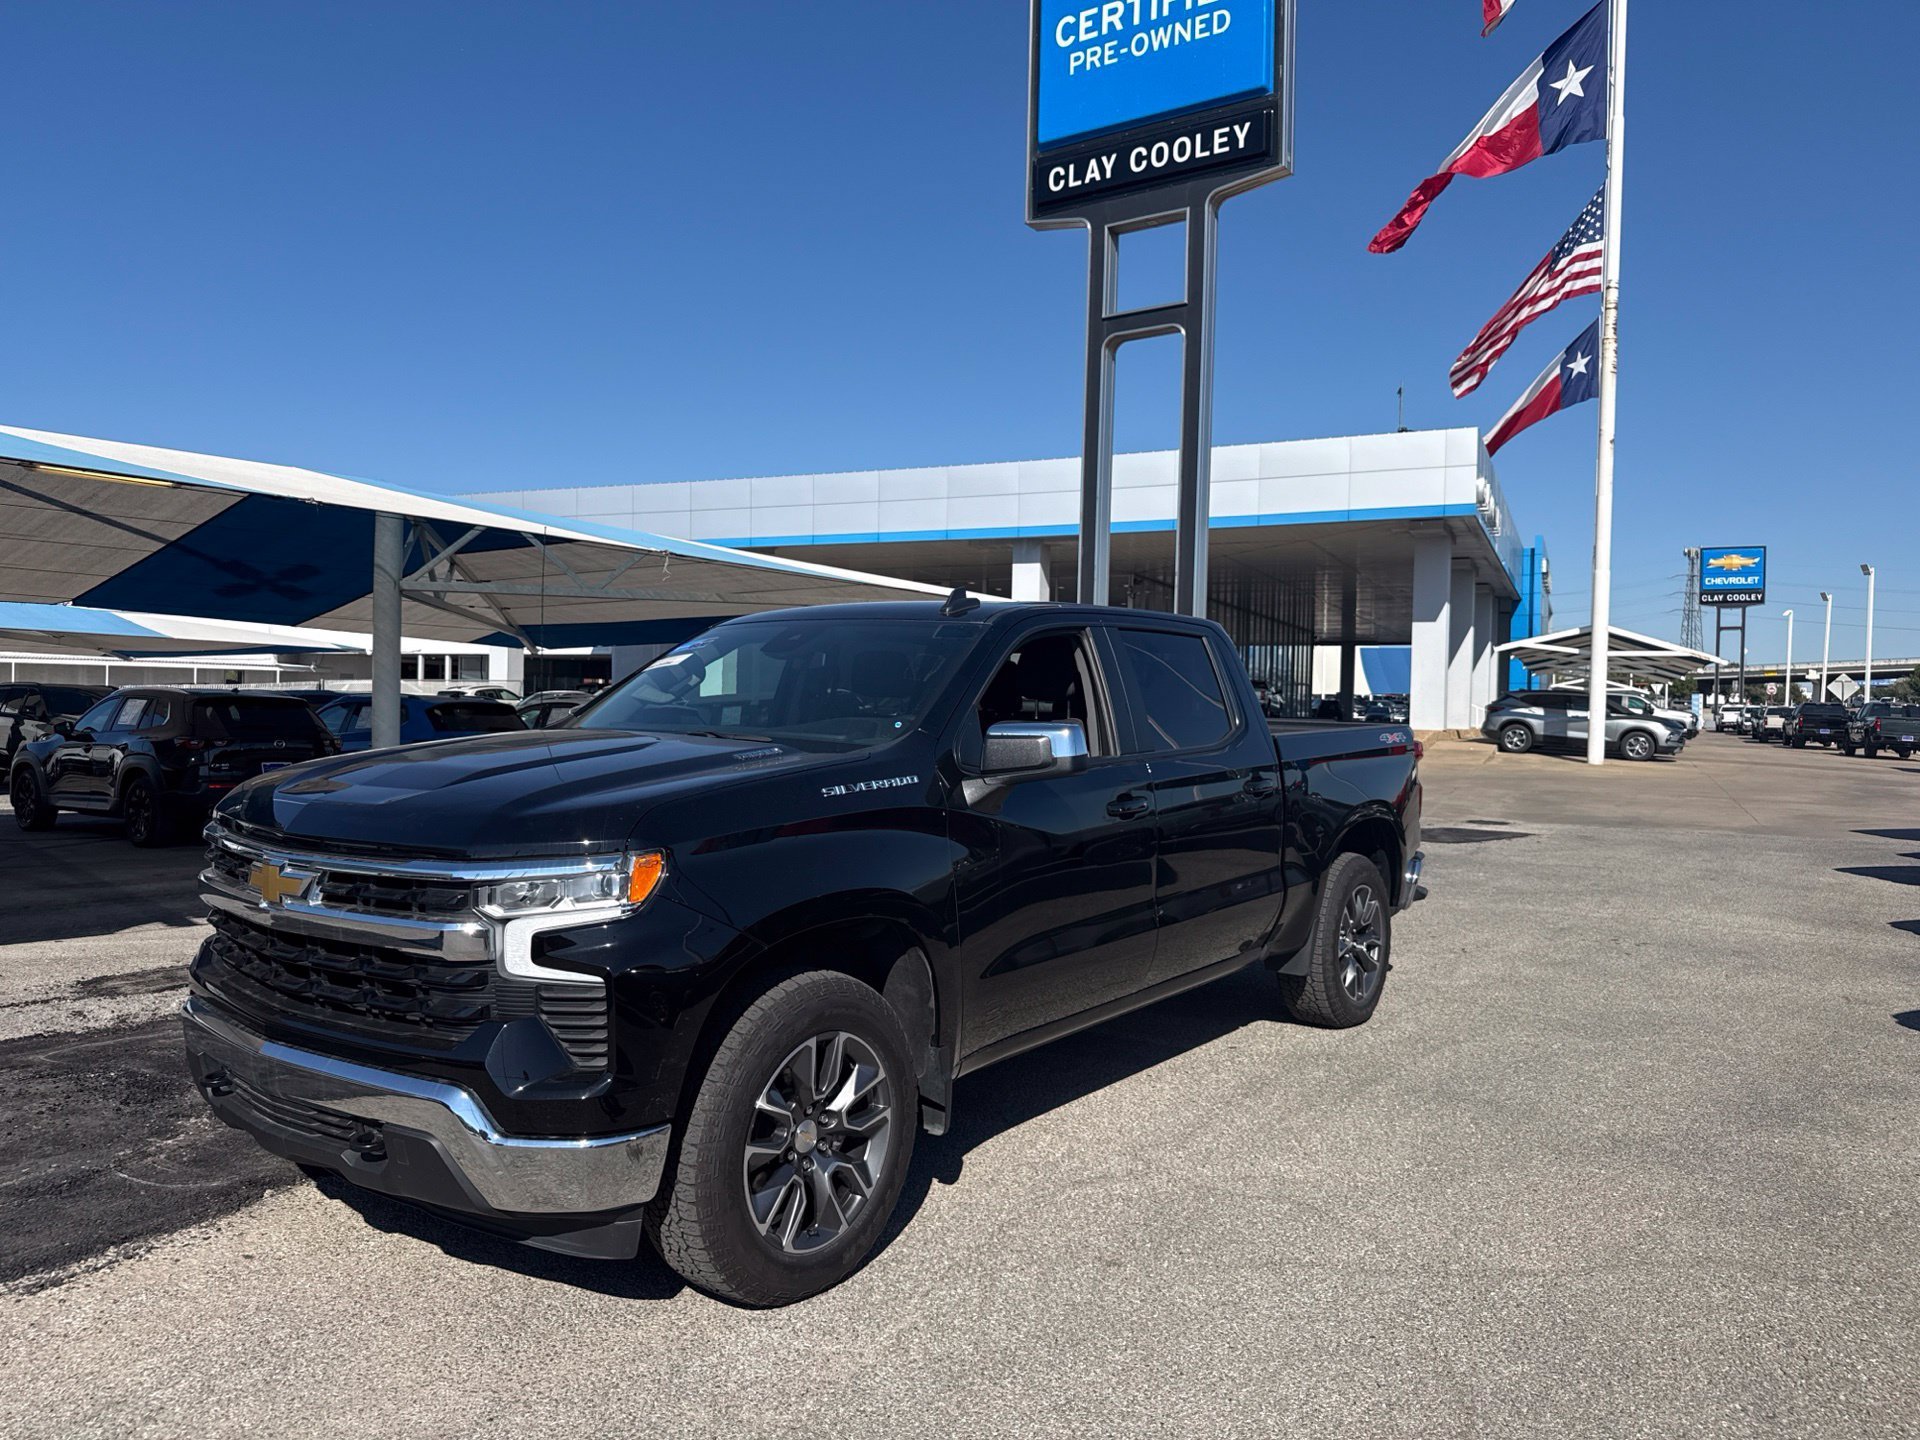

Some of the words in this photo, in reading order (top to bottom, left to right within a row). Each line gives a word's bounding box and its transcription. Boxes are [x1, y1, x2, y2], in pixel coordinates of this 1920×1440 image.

[1055, 0, 1219, 48] CERTIF
[1069, 9, 1231, 76] PRE-OWNED
[1048, 153, 1117, 192] CLAY
[1129, 122, 1251, 173] COOLEY
[1701, 594, 1724, 602] CLAY
[1726, 593, 1763, 602] COOLEY
[1705, 576, 1760, 585] CHEVROLET
[821, 775, 919, 797] SILVERADO
